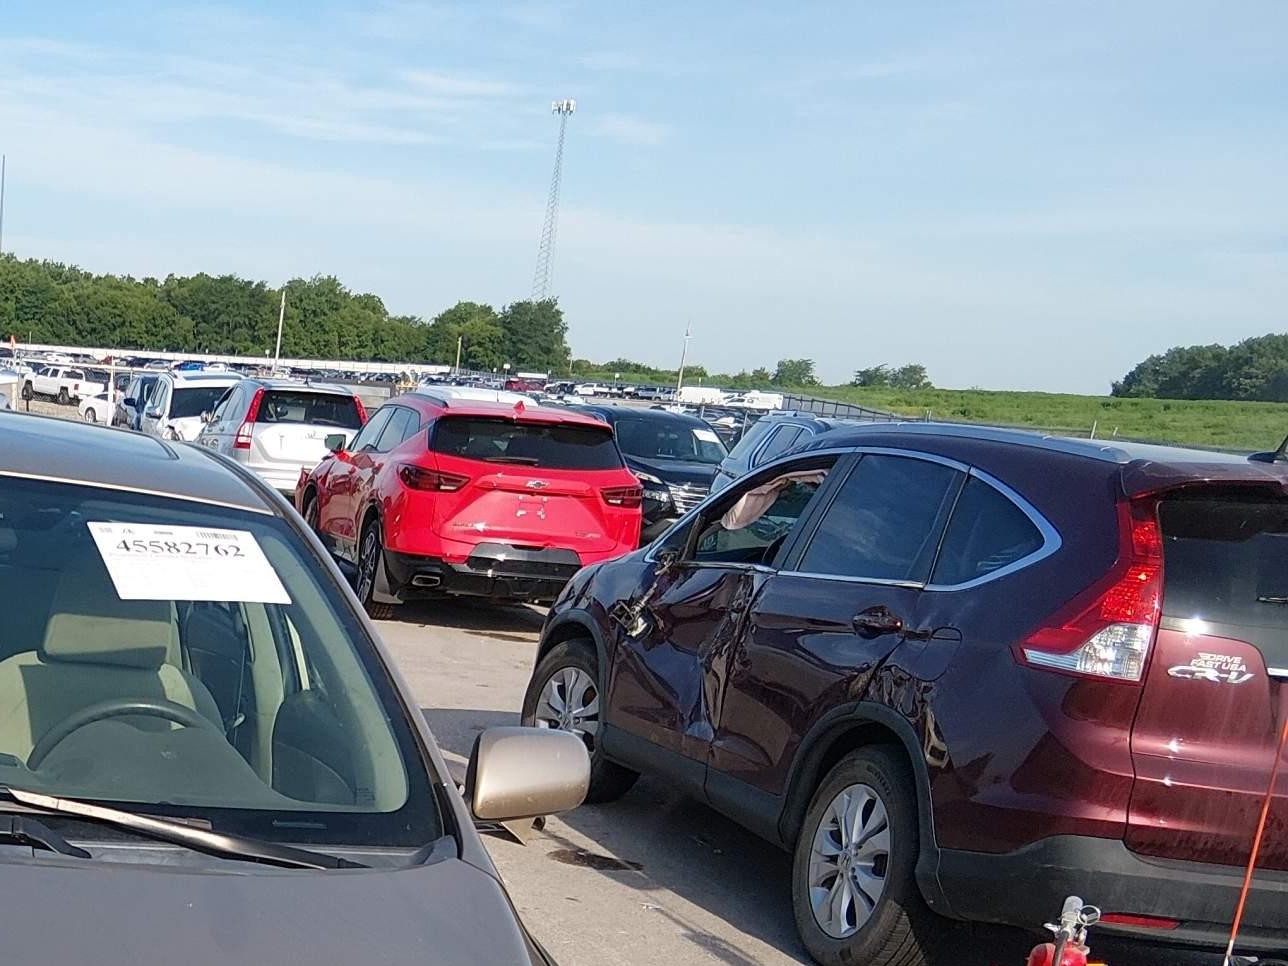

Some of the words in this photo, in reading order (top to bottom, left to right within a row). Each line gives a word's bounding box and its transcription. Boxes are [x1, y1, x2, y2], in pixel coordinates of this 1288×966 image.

[116, 539, 245, 557] 45582762
[1190, 659, 1220, 669] FAST
[1221, 661, 1247, 672] USA
[1198, 652, 1242, 664] DRIVE
[1167, 665, 1255, 684] CR-V
